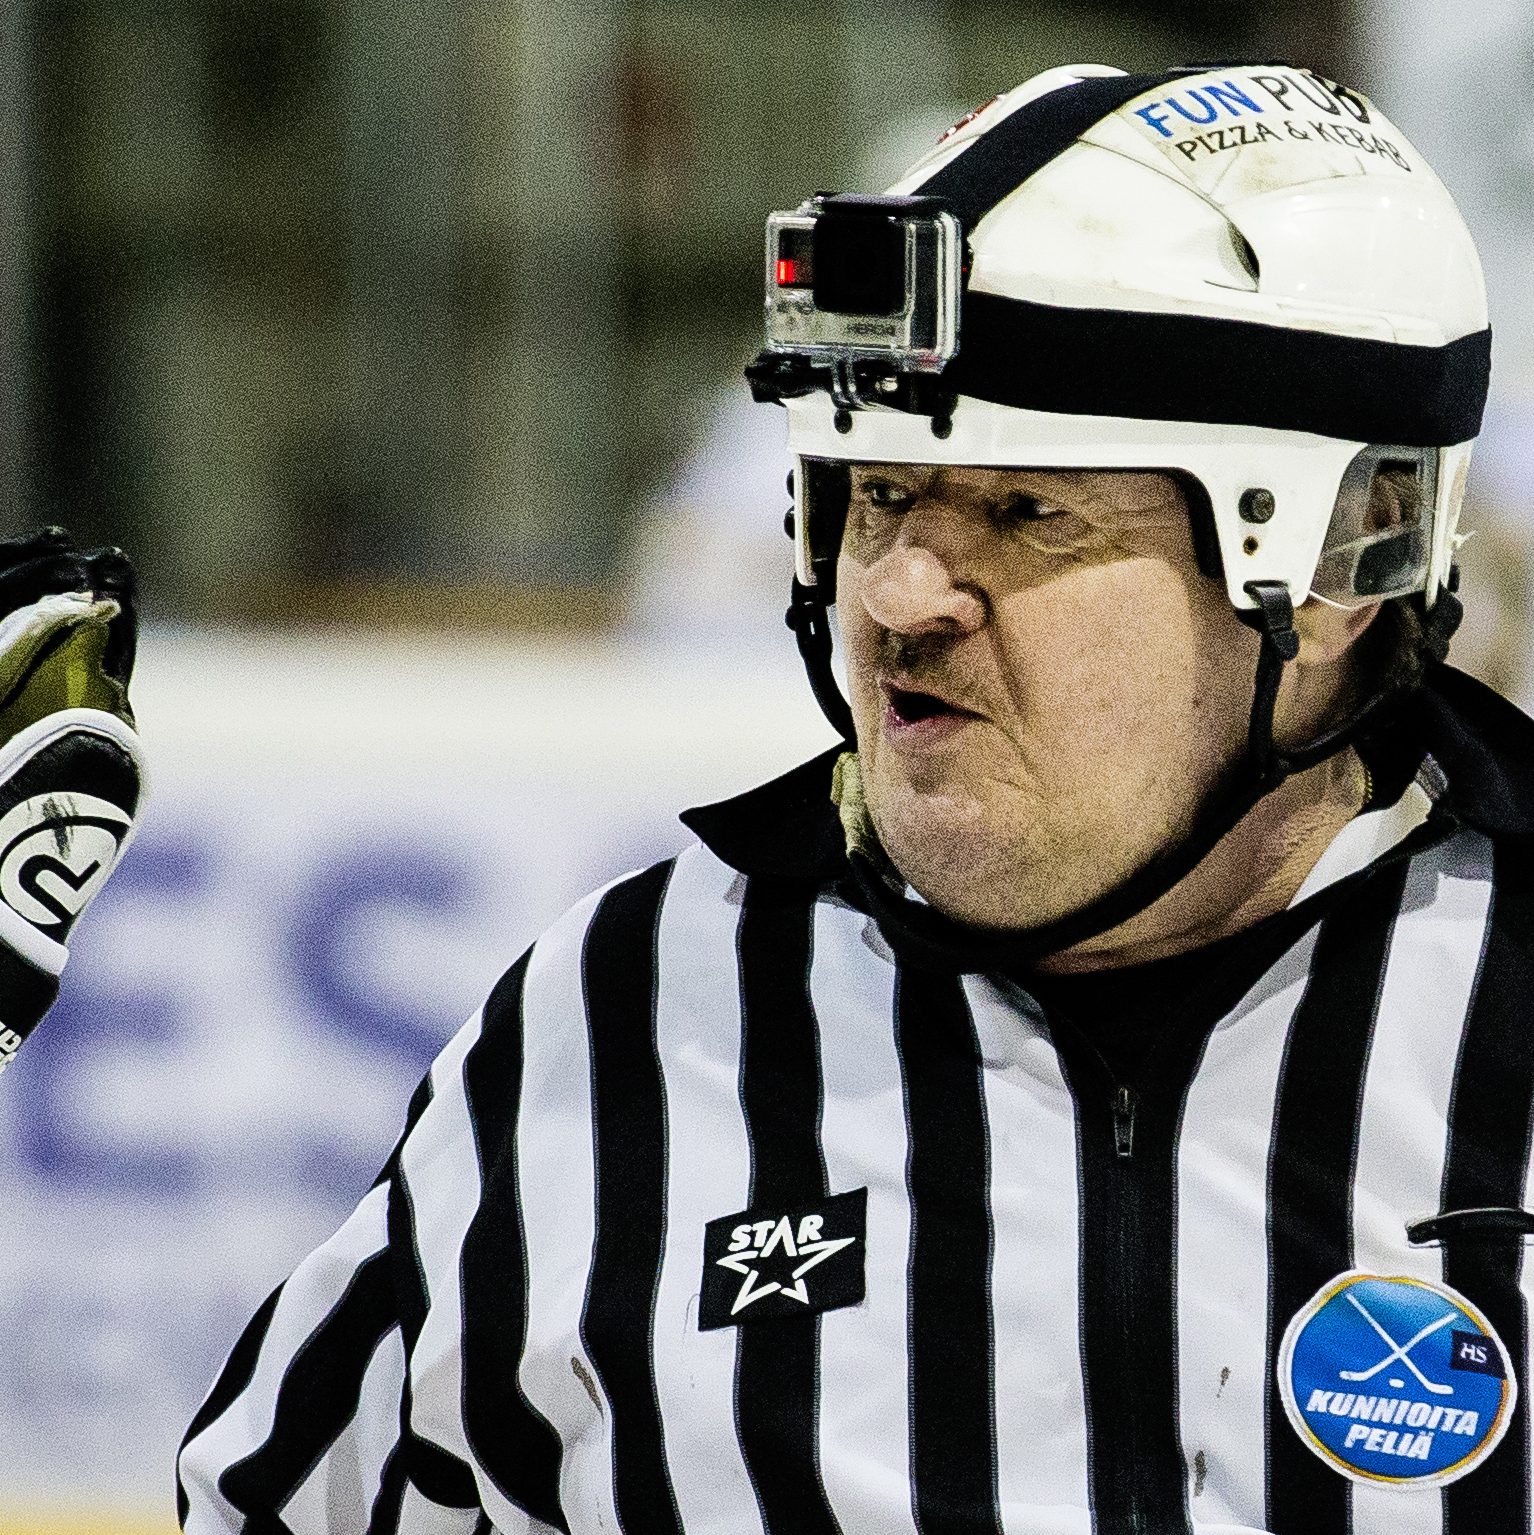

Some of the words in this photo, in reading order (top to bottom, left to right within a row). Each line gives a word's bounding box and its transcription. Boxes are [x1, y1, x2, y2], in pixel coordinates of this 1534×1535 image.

[1134, 80, 1264, 138] FUN
[1249, 73, 1372, 125] PUB
[1175, 121, 1283, 162] PIZZA
[1283, 120, 1314, 141] &
[1306, 119, 1412, 173] KEBAB
[727, 1214, 824, 1258] STAR
[1306, 1388, 1480, 1437] KUNNIOITA
[1343, 1422, 1435, 1461] PELIÄ
